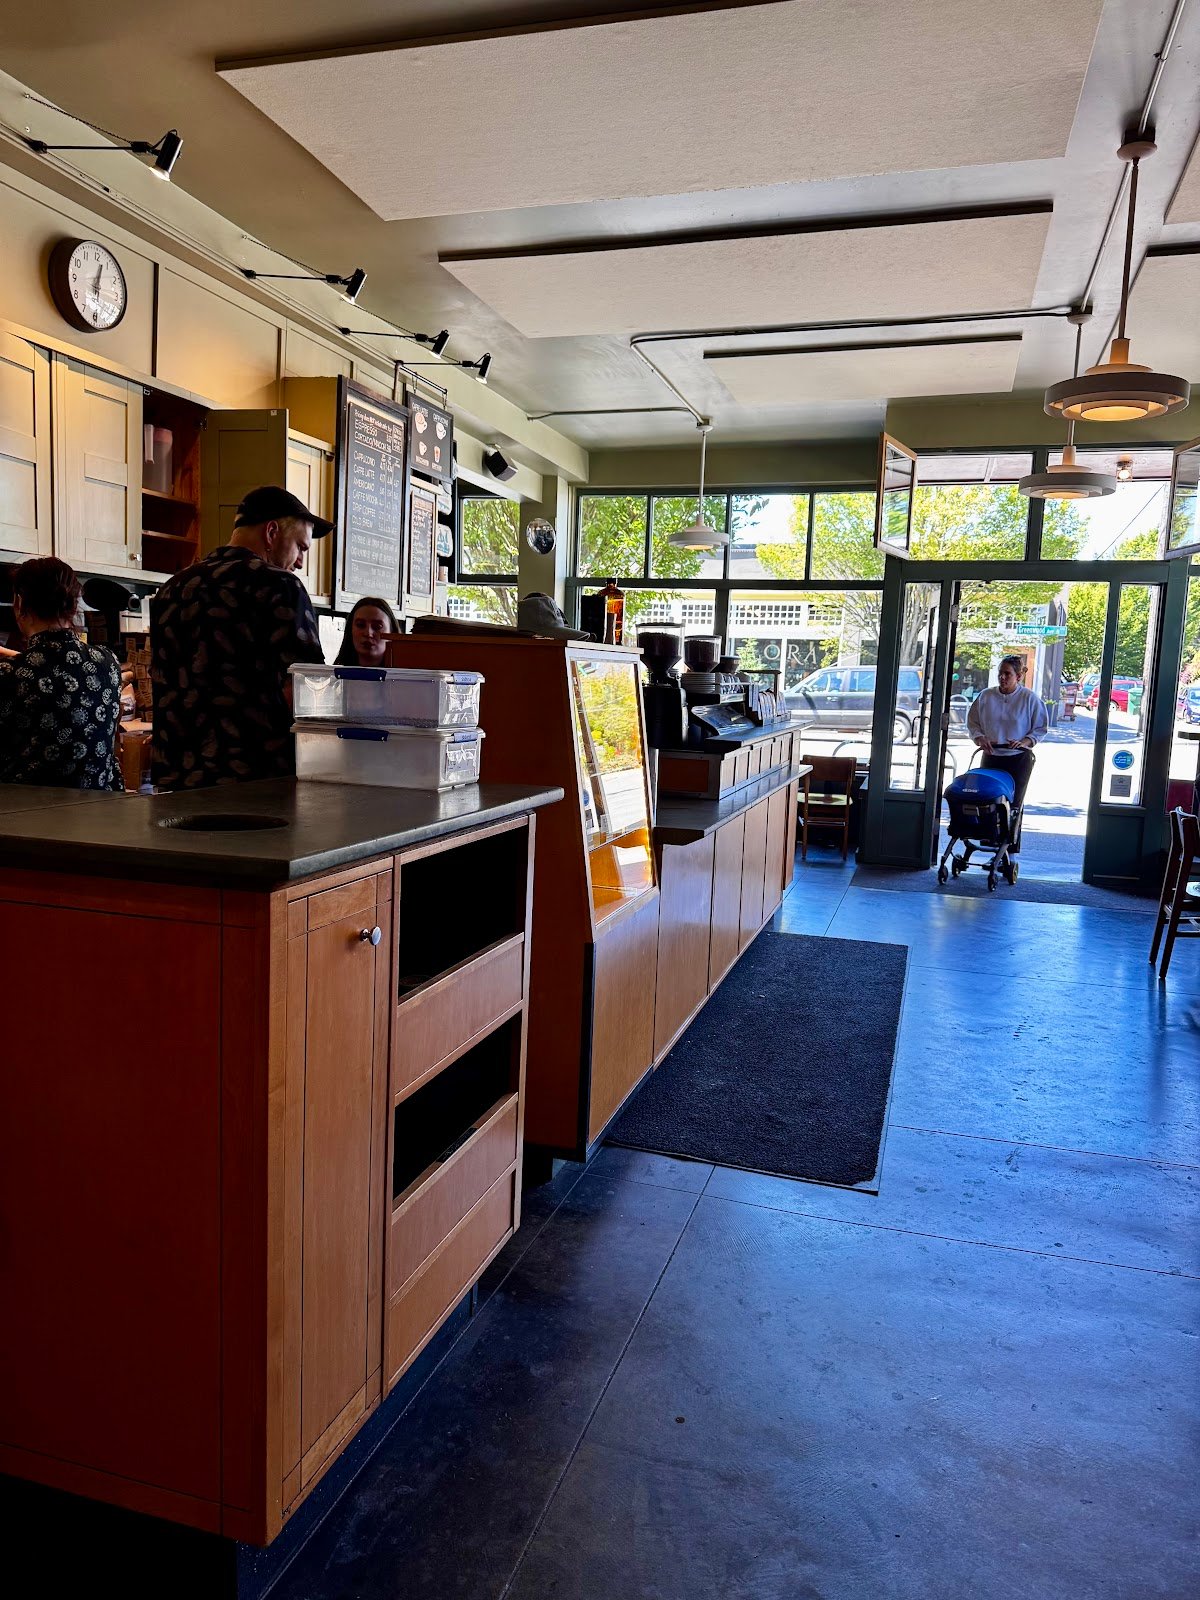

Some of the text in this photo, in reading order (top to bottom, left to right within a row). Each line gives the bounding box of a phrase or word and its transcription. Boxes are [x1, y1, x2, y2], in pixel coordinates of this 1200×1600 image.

[83, 250, 89, 261] 11
[94, 251, 101, 263] 12
[74, 257, 81, 268] 10
[72, 273, 77, 283] 9
[112, 275, 117, 285] 2
[73, 289, 79, 299] 8
[114, 291, 119, 302] 3
[355, 419, 378, 437] ESPRESSO
[1018, 626, 1046, 635] Greenwood
